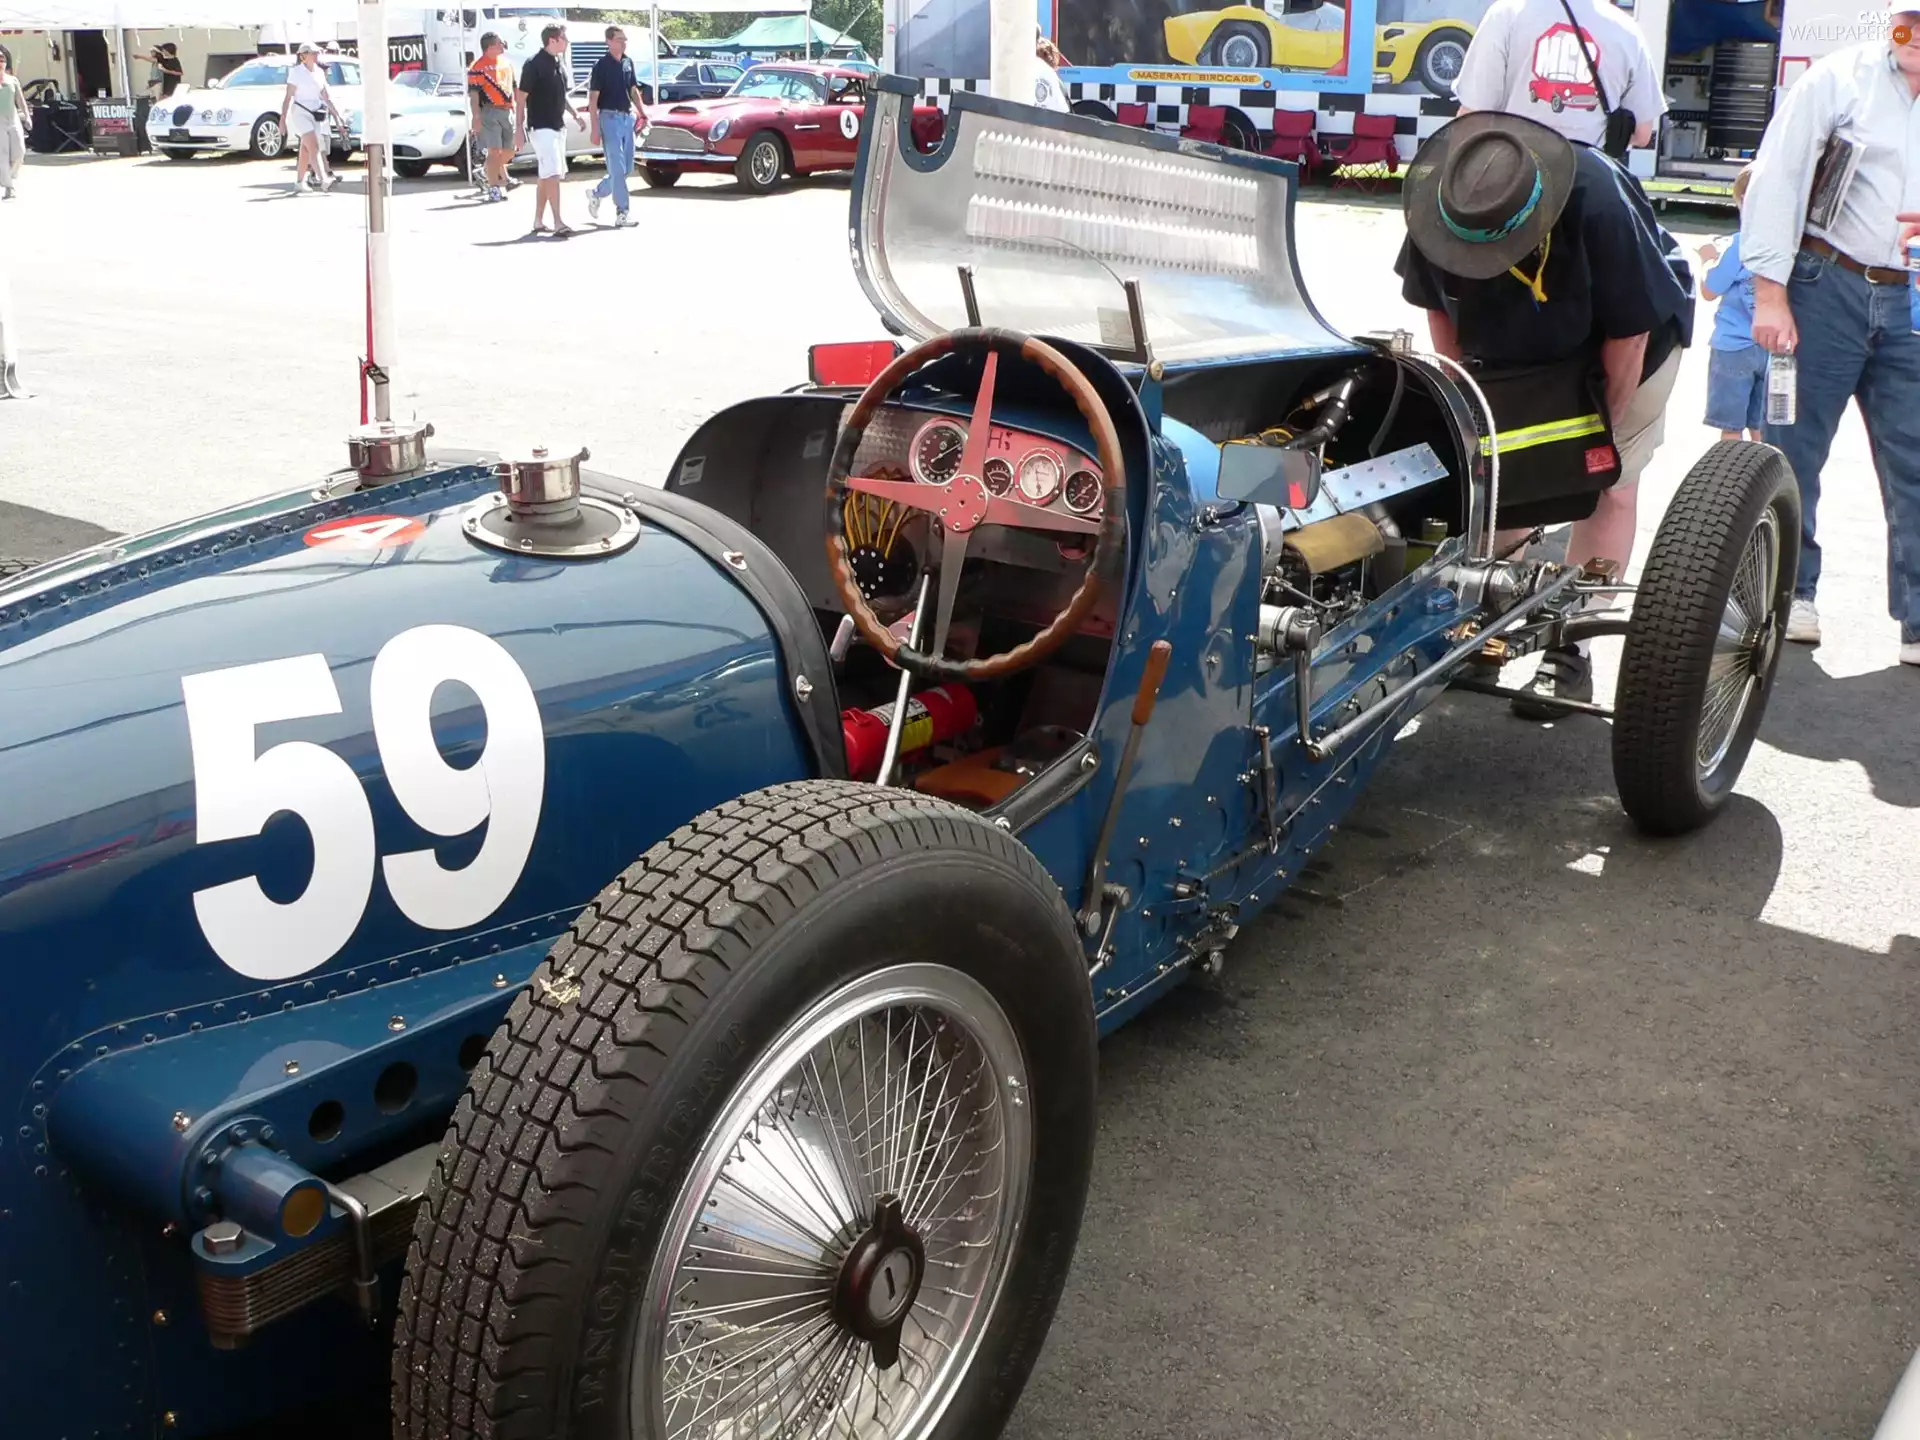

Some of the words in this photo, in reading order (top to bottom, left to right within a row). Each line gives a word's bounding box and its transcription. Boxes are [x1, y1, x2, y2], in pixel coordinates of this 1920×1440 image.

[1136, 71, 1192, 81] MASERATI
[92, 104, 137, 119] WELCOME
[845, 113, 853, 133] 4
[181, 624, 545, 981] 59
